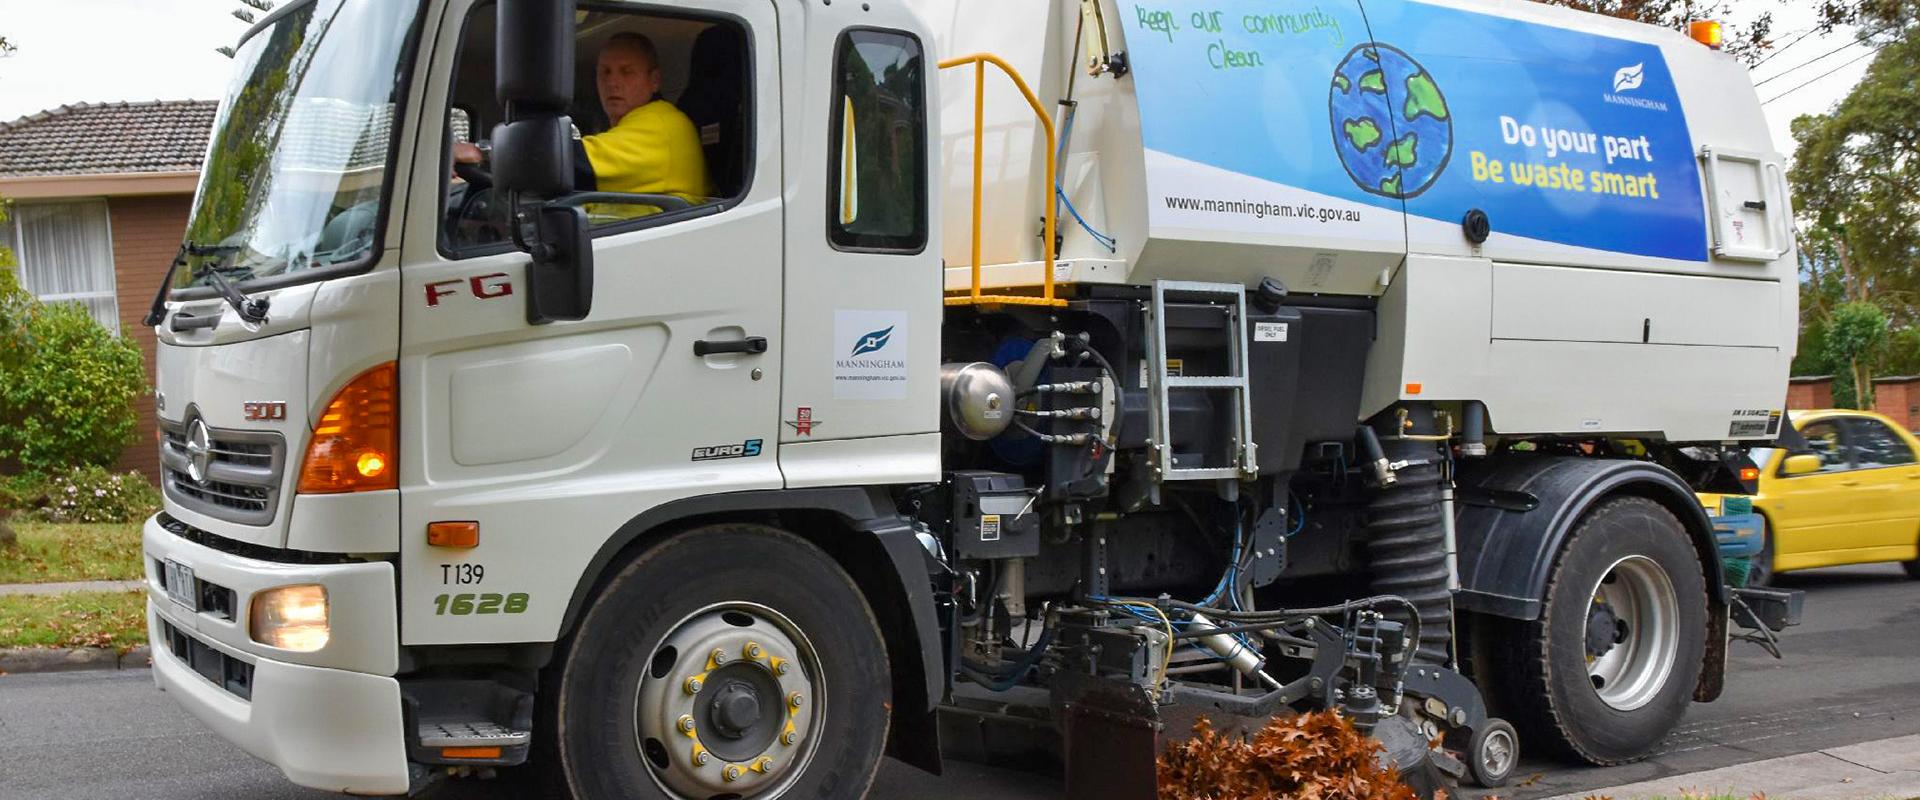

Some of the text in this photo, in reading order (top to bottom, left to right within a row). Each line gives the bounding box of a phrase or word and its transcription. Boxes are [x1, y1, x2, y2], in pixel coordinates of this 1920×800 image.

[1191, 10, 1223, 33] our
[1243, 6, 1344, 48] community
[1207, 39, 1264, 70] Clean
[1603, 93, 1668, 112] MANNINGHAM
[1500, 115, 1653, 164] Do your part
[1471, 151, 1659, 199] Be waste smart
[1165, 196, 1361, 223] www.manningham.vic.gov.au
[424, 272, 513, 307] FG
[836, 359, 905, 369] MANNINGHAM
[434, 592, 530, 616] 1628
